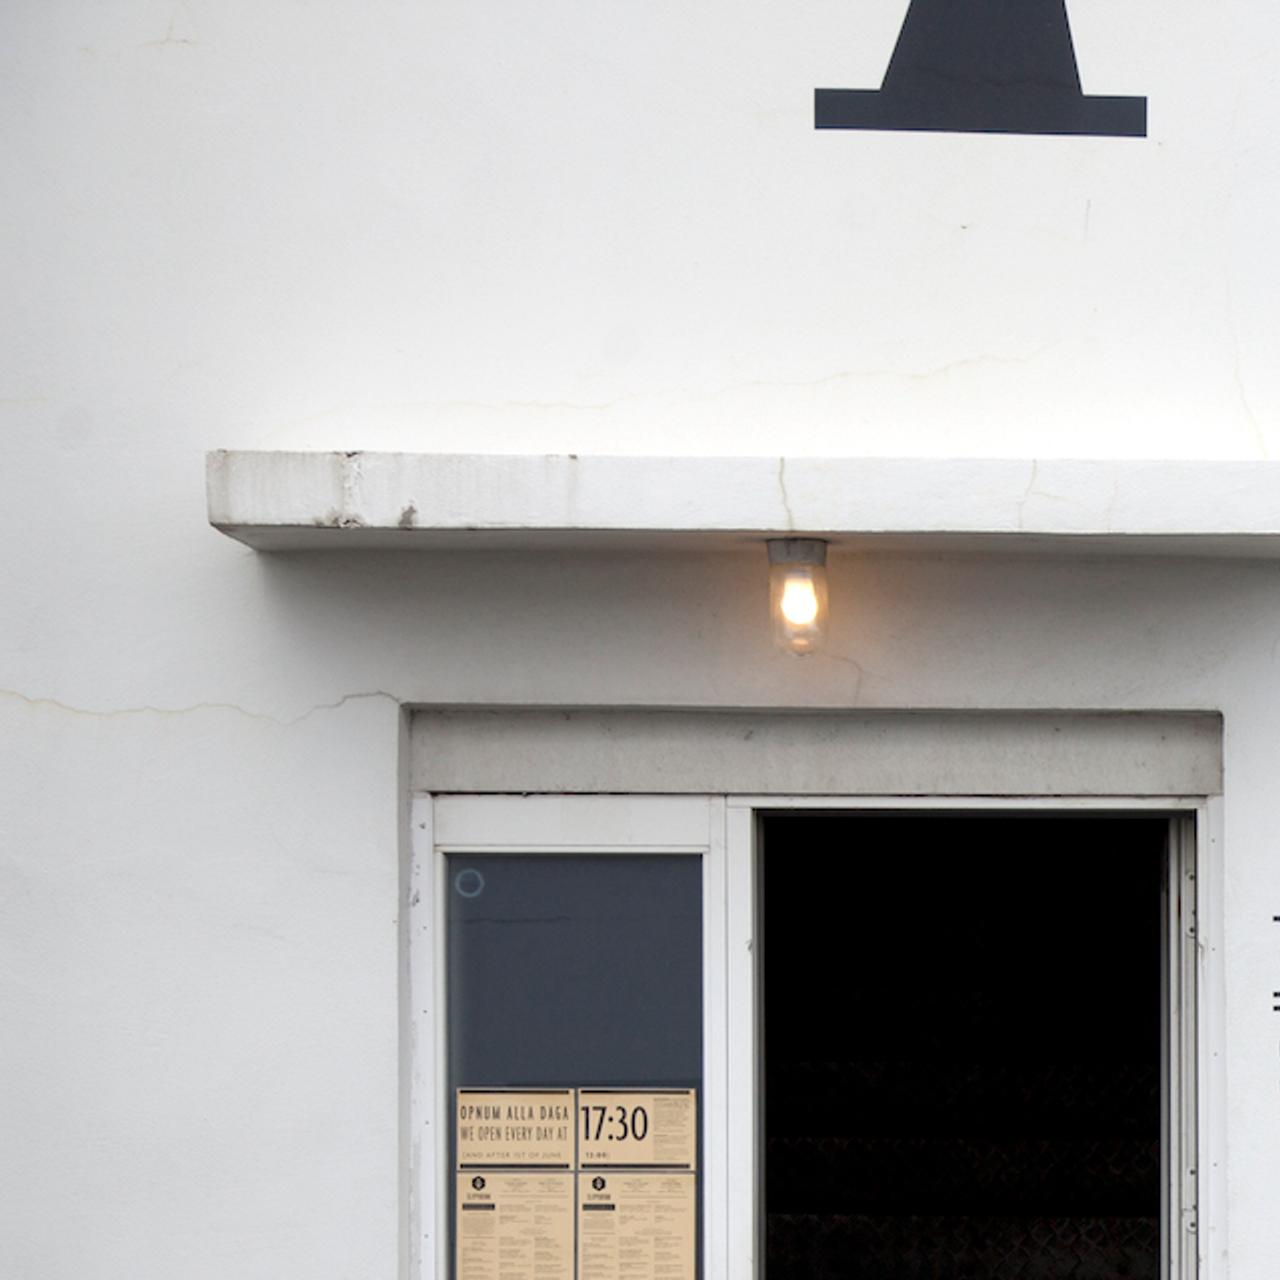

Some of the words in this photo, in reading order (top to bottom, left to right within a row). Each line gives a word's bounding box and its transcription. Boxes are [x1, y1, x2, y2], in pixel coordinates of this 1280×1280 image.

[460, 1105, 501, 1121] OPNUM
[506, 1105, 534, 1121] ALLA
[540, 1105, 569, 1121] DAGA
[580, 1105, 649, 1142] 17:30
[460, 1126, 475, 1142] WE
[478, 1126, 502, 1142] OPEN
[505, 1126, 533, 1142] EVERY
[536, 1126, 554, 1142] DAY
[557, 1126, 568, 1142] AT
